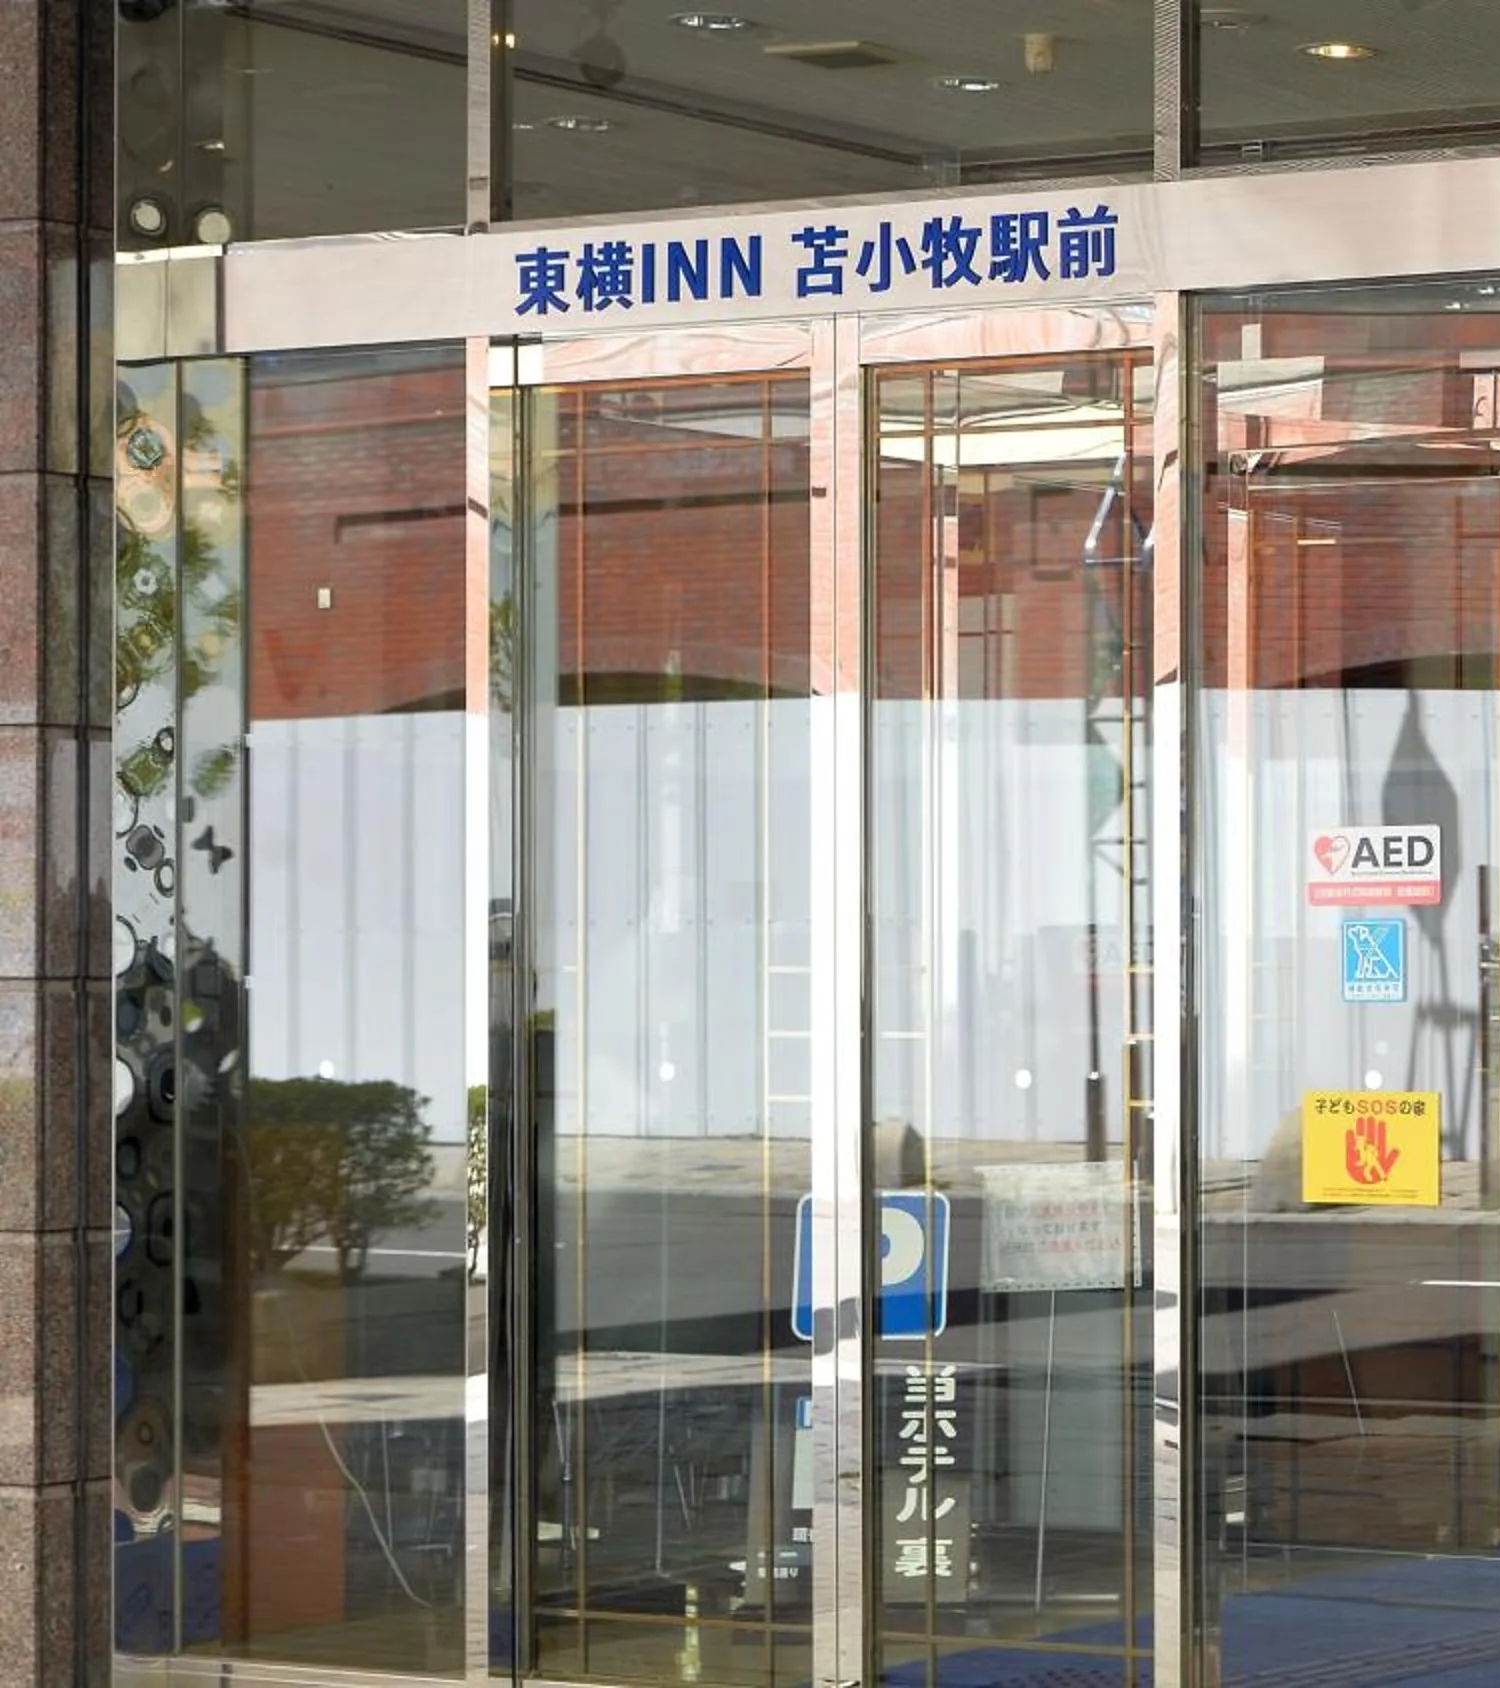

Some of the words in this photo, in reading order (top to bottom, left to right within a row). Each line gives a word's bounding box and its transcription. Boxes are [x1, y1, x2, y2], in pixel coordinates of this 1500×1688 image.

[515, 235, 762, 315] 東横INN
[791, 203, 1119, 298] 苫小牧駅前
[1351, 836, 1434, 868] AED
[1315, 1097, 1426, 1117] 子どもSOSの家
